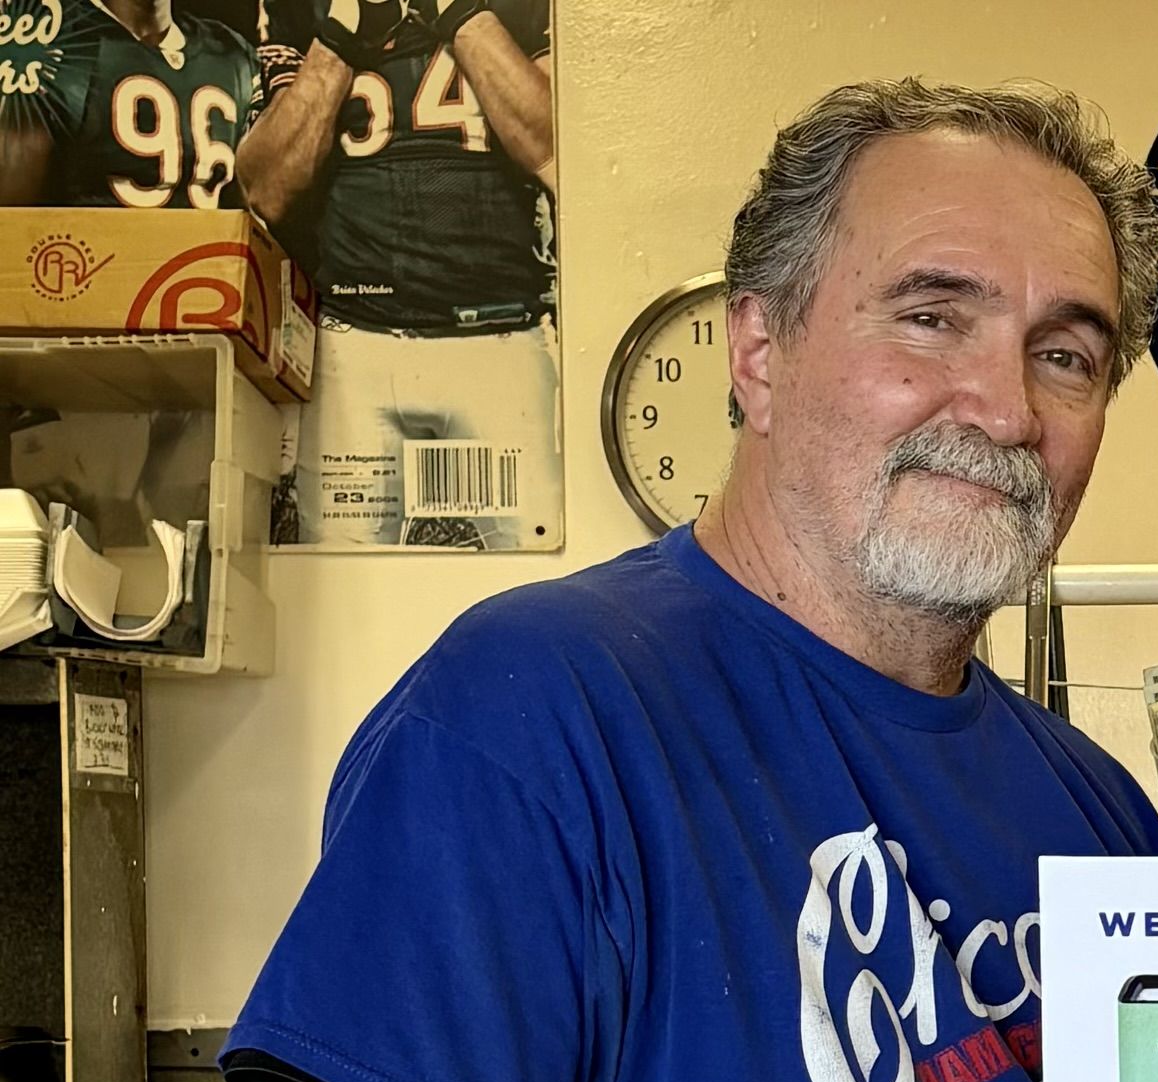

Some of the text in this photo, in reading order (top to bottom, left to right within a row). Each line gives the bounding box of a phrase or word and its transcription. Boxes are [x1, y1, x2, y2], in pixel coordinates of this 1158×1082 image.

[108, 74, 237, 209] 96
[692, 320, 713, 345] 11
[654, 357, 682, 383] 10
[642, 404, 658, 430] 9
[659, 456, 674, 481] 8
[334, 492, 365, 504] 23
